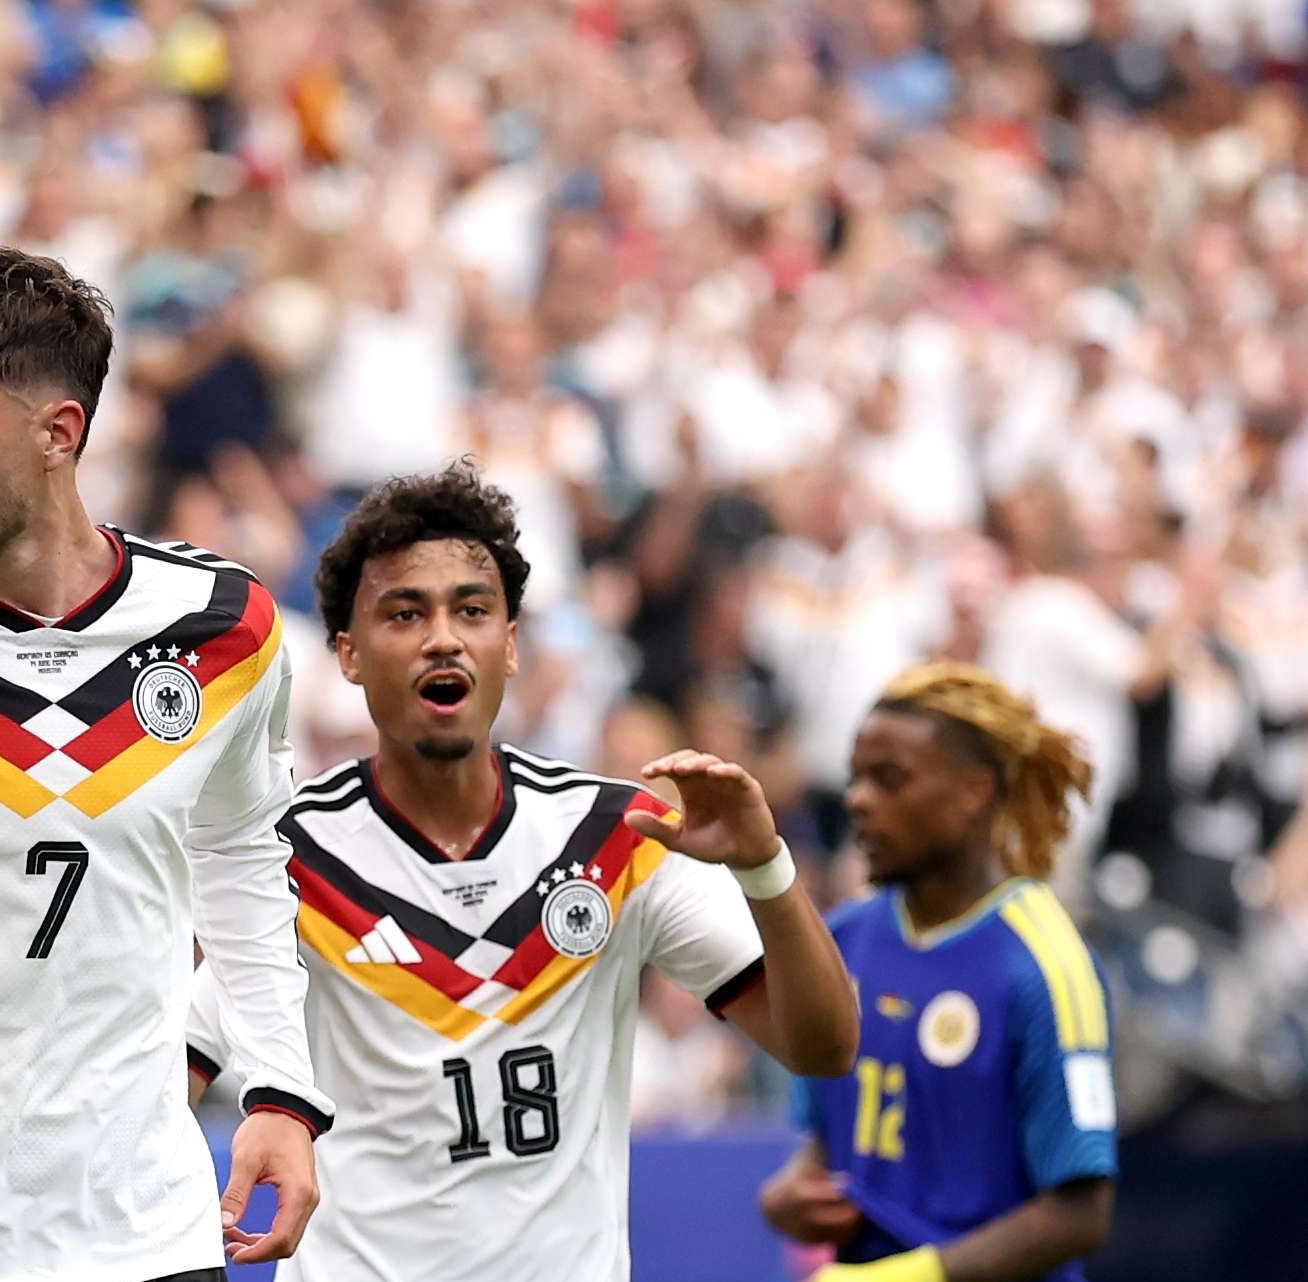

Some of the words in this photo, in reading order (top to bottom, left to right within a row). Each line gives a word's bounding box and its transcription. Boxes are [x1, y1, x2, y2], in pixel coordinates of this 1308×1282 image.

[25, 841, 89, 959] 7
[442, 1044, 560, 1164] 18
[854, 1058, 906, 1162] 12
